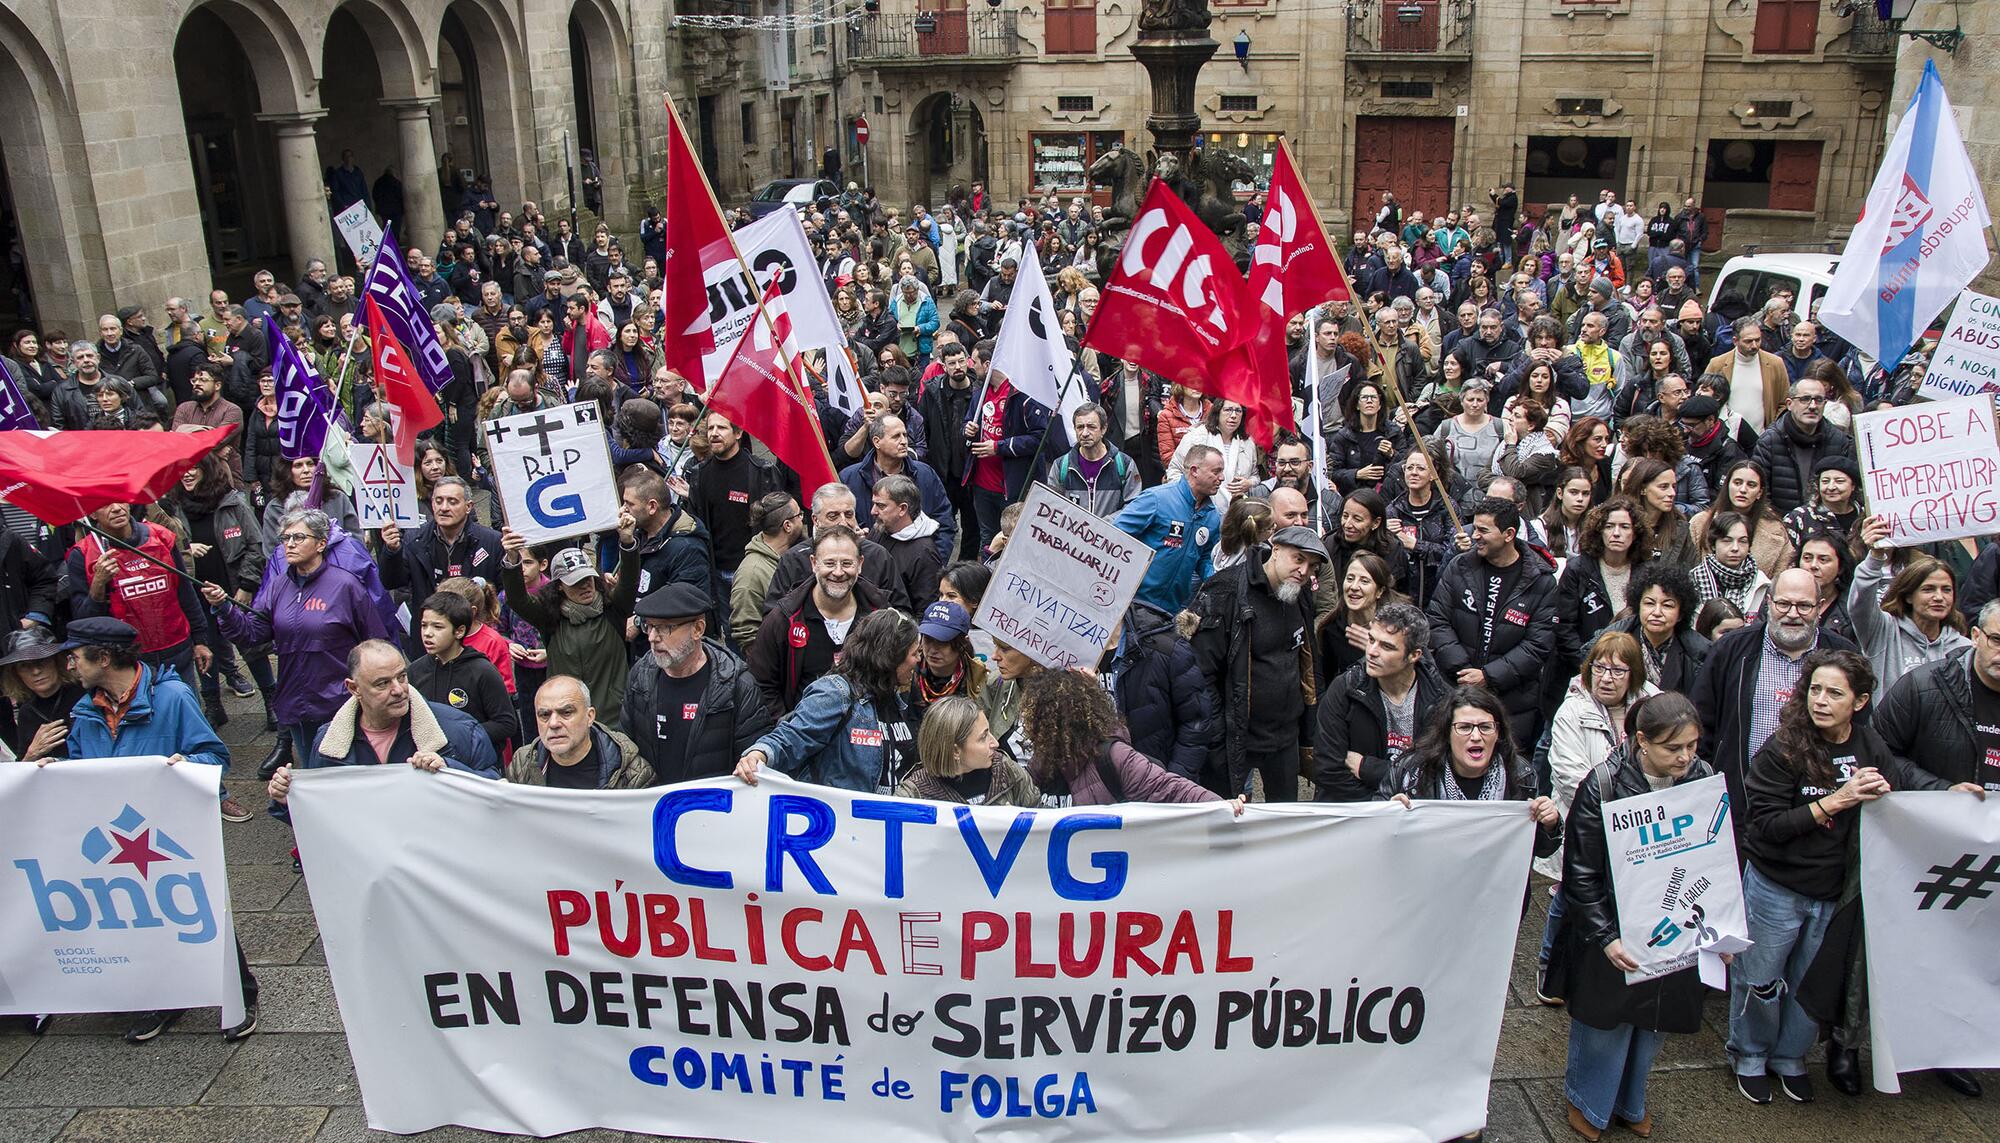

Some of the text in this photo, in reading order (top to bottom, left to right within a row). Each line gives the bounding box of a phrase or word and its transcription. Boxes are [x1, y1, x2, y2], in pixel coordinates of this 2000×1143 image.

[1884, 408, 1987, 448] SOBE A
[1868, 457, 1998, 500] TEMPERATURA
[364, 503, 411, 520] MAL
[526, 472, 586, 529] G
[1908, 490, 1998, 532] CRTVG
[1037, 502, 1133, 563] DEIXÁDENOS
[123, 578, 167, 597] CCOO
[1007, 572, 1109, 649] PRIVATIZAR
[989, 606, 1078, 668] PREVARICAR
[850, 736, 882, 746] FOLGA
[1612, 805, 1666, 832] Asina a
[1638, 814, 1694, 846] ILP
[652, 787, 1129, 901] CRTVG
[1625, 848, 1645, 856] Contra
[1650, 837, 1686, 850] manipulación
[1673, 842, 1692, 850] Galega
[13, 858, 217, 944] bng
[1661, 866, 1687, 911] LIBEREMOS
[1678, 876, 1712, 910] A GALEGA
[54, 947, 96, 957] BLOQUE
[57, 956, 131, 966] NACIONALISTA
[899, 911, 943, 976] E
[961, 909, 1254, 981] PLURAL
[62, 965, 103, 975] GALEGO
[423, 971, 521, 1030] EN
[544, 969, 851, 1047] DEFENSA
[867, 991, 925, 1037] do
[871, 1067, 915, 1100] de
[941, 1069, 1099, 1119] FOLGA
